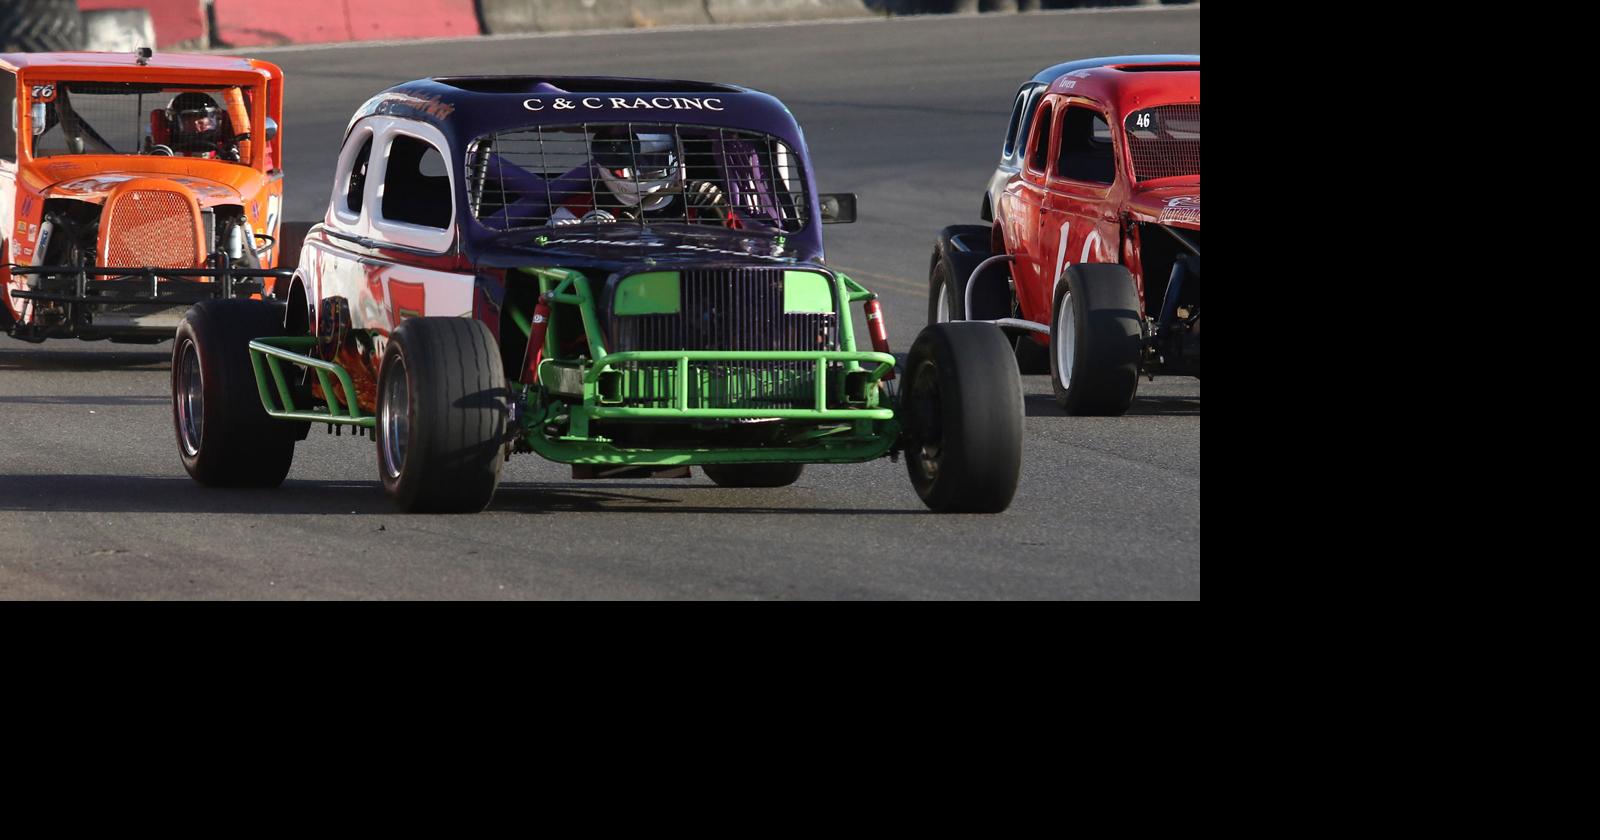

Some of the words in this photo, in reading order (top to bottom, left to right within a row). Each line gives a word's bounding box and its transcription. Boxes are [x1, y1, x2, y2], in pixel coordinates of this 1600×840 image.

[31, 84, 54, 98] 76
[523, 98, 544, 111] C
[552, 97, 576, 110] &
[582, 97, 604, 109] C
[1136, 113, 1150, 128] 46
